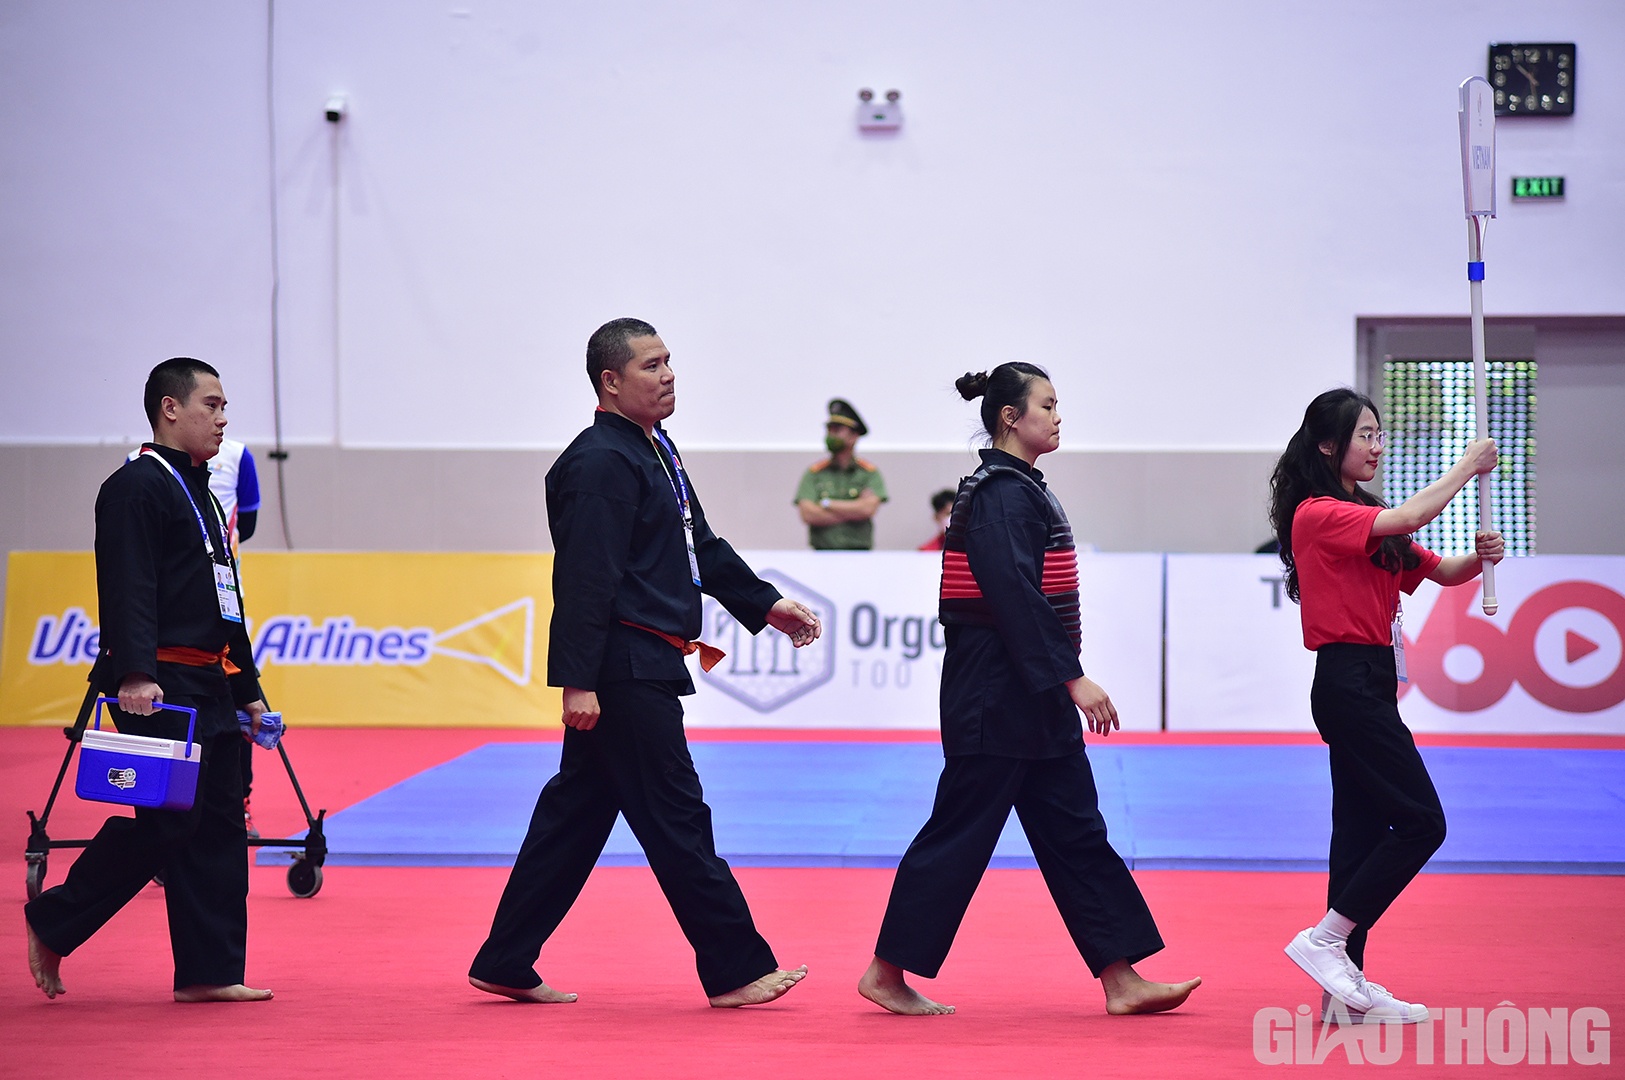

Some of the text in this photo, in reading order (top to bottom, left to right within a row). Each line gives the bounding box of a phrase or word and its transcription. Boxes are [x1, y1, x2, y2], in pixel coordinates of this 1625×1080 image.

[1472, 145, 1491, 169] VIETNAM
[1516, 178, 1559, 196] EXIT
[32, 610, 430, 663] Vie Airlines
[851, 603, 946, 660] Orga
[1397, 580, 1625, 713] 60
